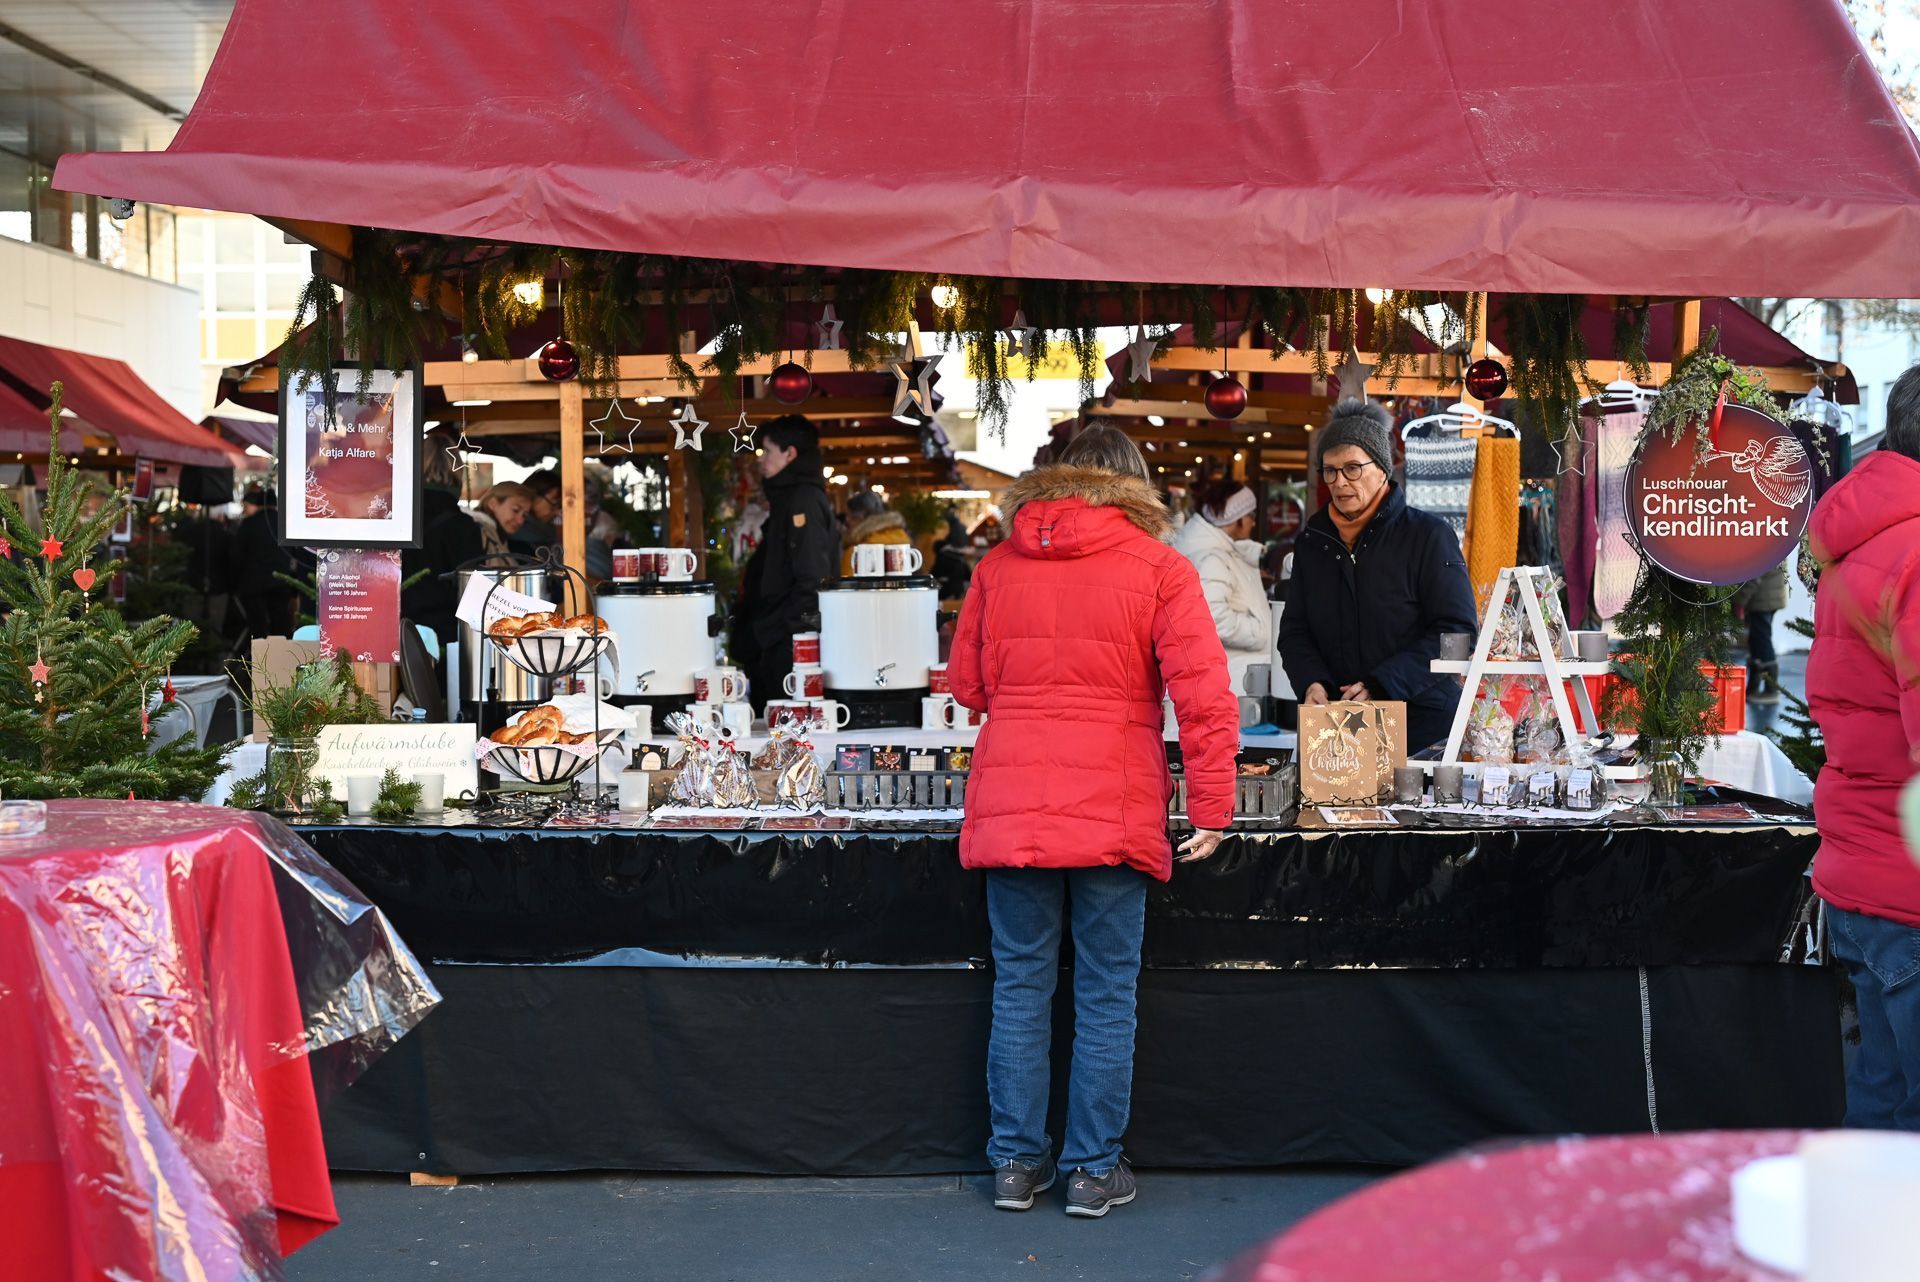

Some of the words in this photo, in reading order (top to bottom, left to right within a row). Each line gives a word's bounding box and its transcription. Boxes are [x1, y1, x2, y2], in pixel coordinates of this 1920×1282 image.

[319, 423, 345, 432] Wen
[346, 423, 355, 433] &
[358, 423, 385, 433] Mehr
[319, 447, 344, 459] Katja
[346, 447, 376, 458] Alfare
[1642, 477, 1728, 490] Luschnouar
[1642, 493, 1757, 515] Chrischt-
[1643, 515, 1789, 537] kendlimarkt
[491, 593, 511, 607] REZEL
[327, 731, 457, 755] Aufwärmstube
[407, 755, 458, 769] Glühwein
[1308, 751, 1360, 771] Christmas
